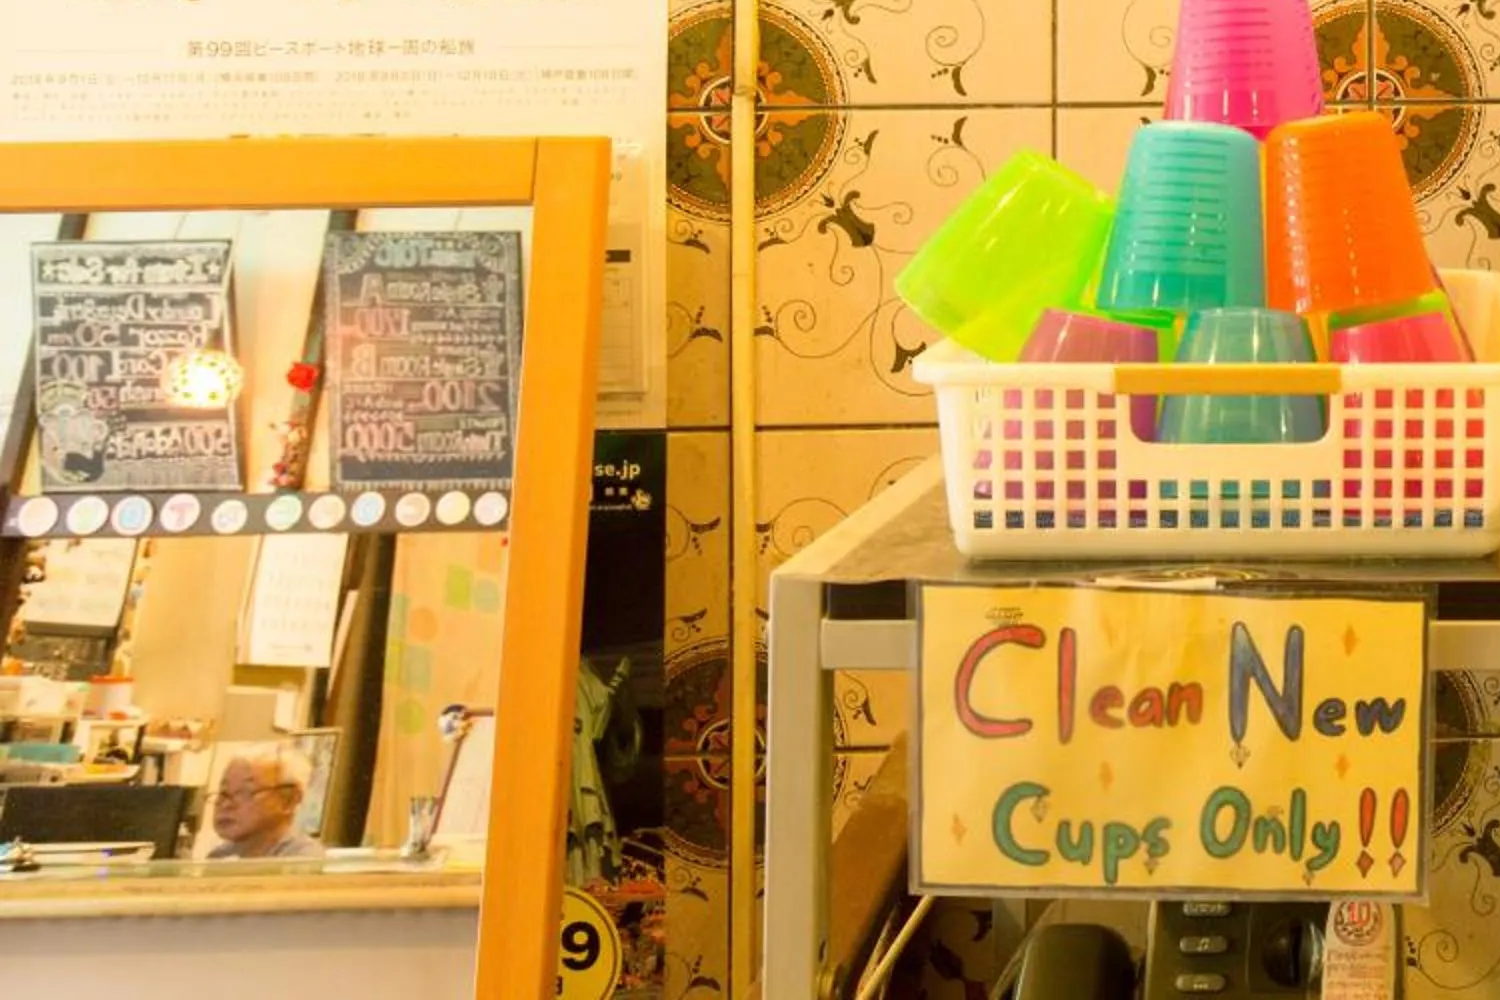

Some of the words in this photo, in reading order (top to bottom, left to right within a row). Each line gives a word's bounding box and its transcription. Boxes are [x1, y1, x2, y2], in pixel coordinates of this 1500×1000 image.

[955, 624, 1204, 744] Clean
[1227, 620, 1407, 743] New
[992, 781, 1174, 885] Cups
